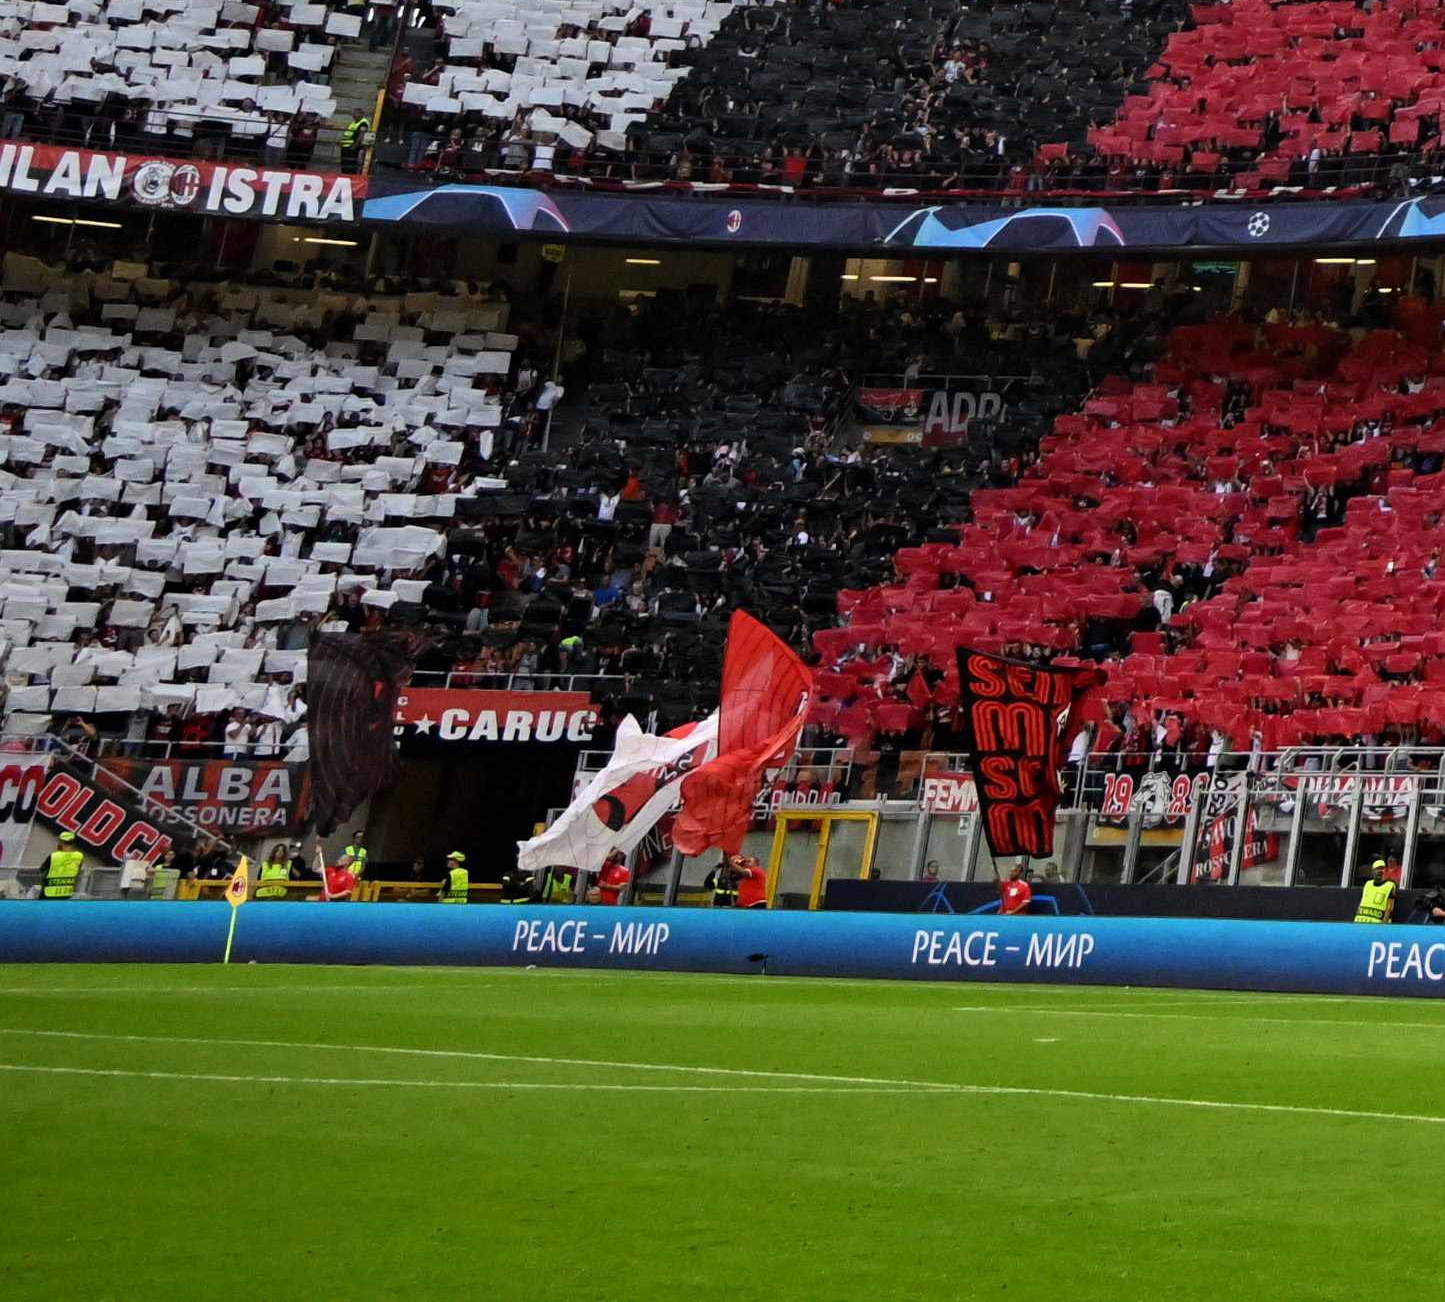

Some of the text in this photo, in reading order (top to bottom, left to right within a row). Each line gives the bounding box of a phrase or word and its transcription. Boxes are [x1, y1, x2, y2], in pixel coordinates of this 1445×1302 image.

[205, 166, 355, 221] ISTRA
[138, 766, 292, 802] ALBA
[37, 772, 127, 846] OLD
[512, 920, 588, 953] PEACE
[912, 930, 999, 966] PEACE
